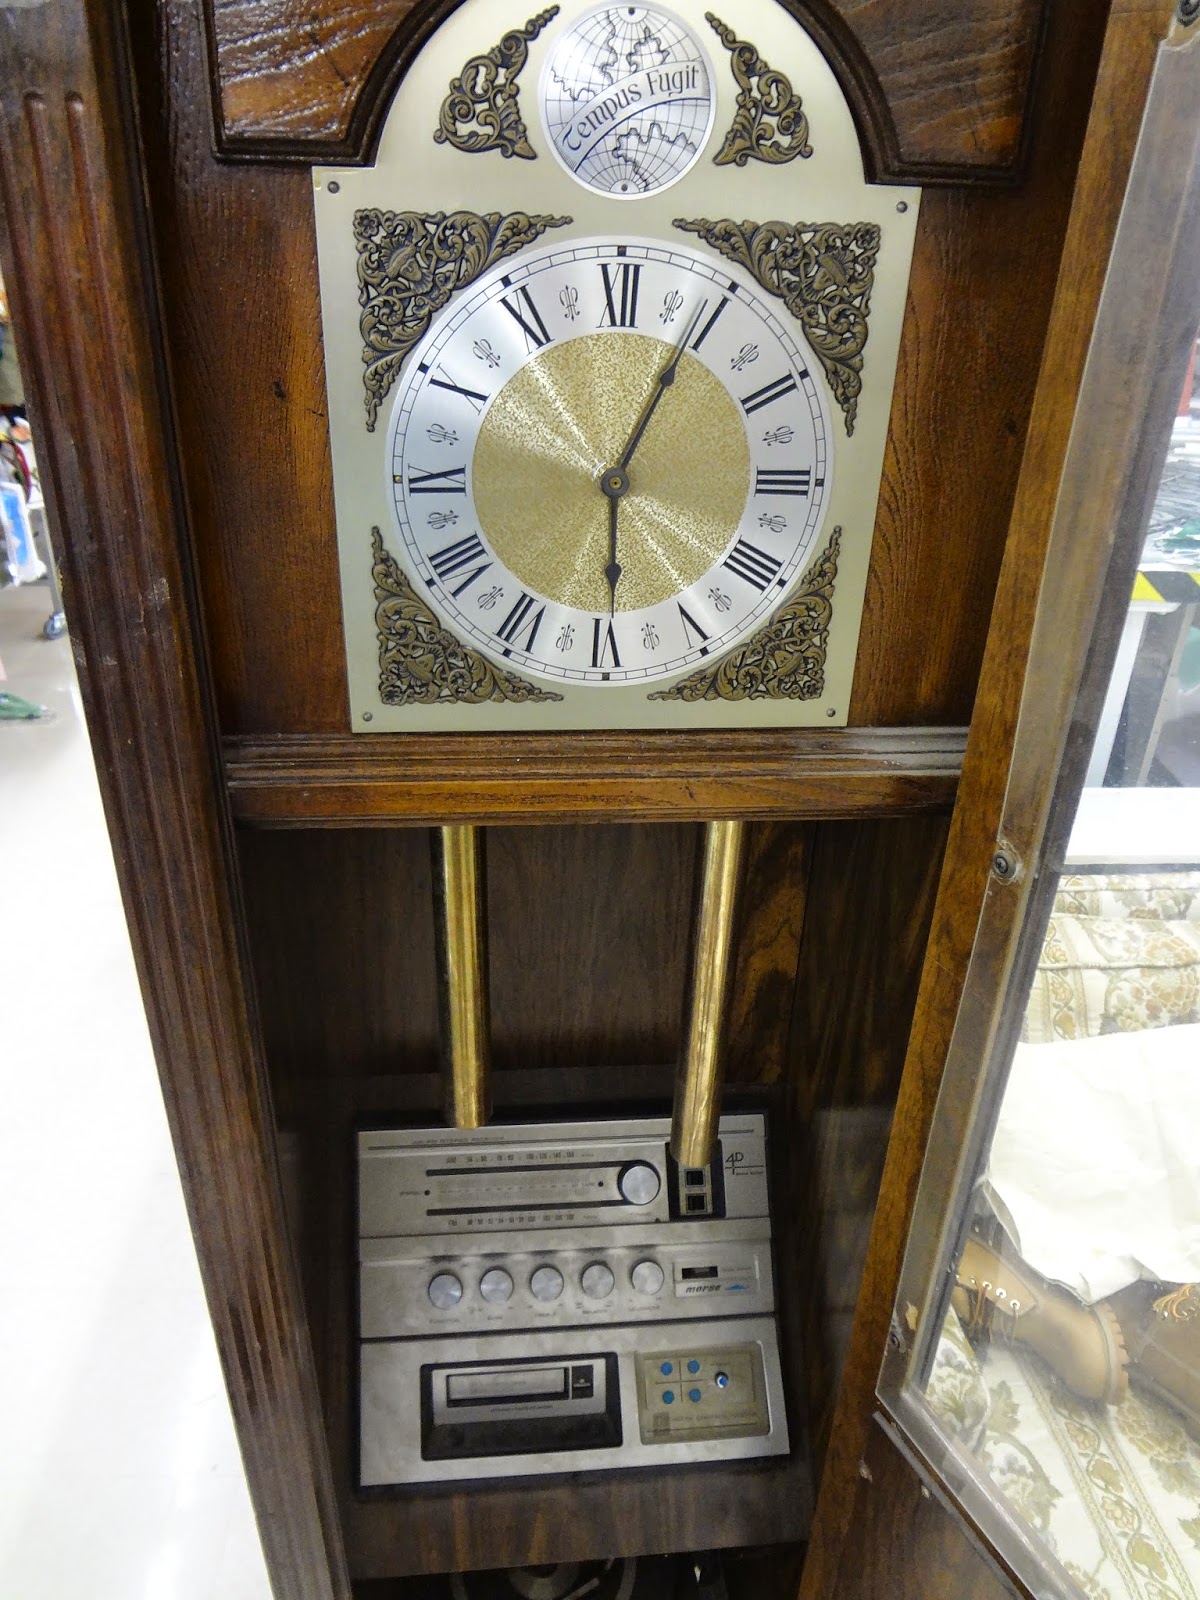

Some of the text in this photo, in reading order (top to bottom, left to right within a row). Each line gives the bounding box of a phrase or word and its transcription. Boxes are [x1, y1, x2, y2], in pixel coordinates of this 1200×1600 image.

[562, 65, 700, 151] Tempus Fugit
[497, 283, 555, 354] XI
[596, 263, 644, 328] XII
[690, 295, 732, 352] I
[428, 363, 492, 416] X
[739, 369, 799, 418] II
[407, 463, 467, 497] IX
[755, 465, 811, 499] III
[426, 531, 495, 599] VIII
[719, 535, 785, 595] IIII
[493, 590, 547, 653] VII
[589, 617, 625, 668] VI
[676, 600, 713, 650] V
[724, 1152, 745, 1175] 4D
[685, 1284, 722, 1294] morse
